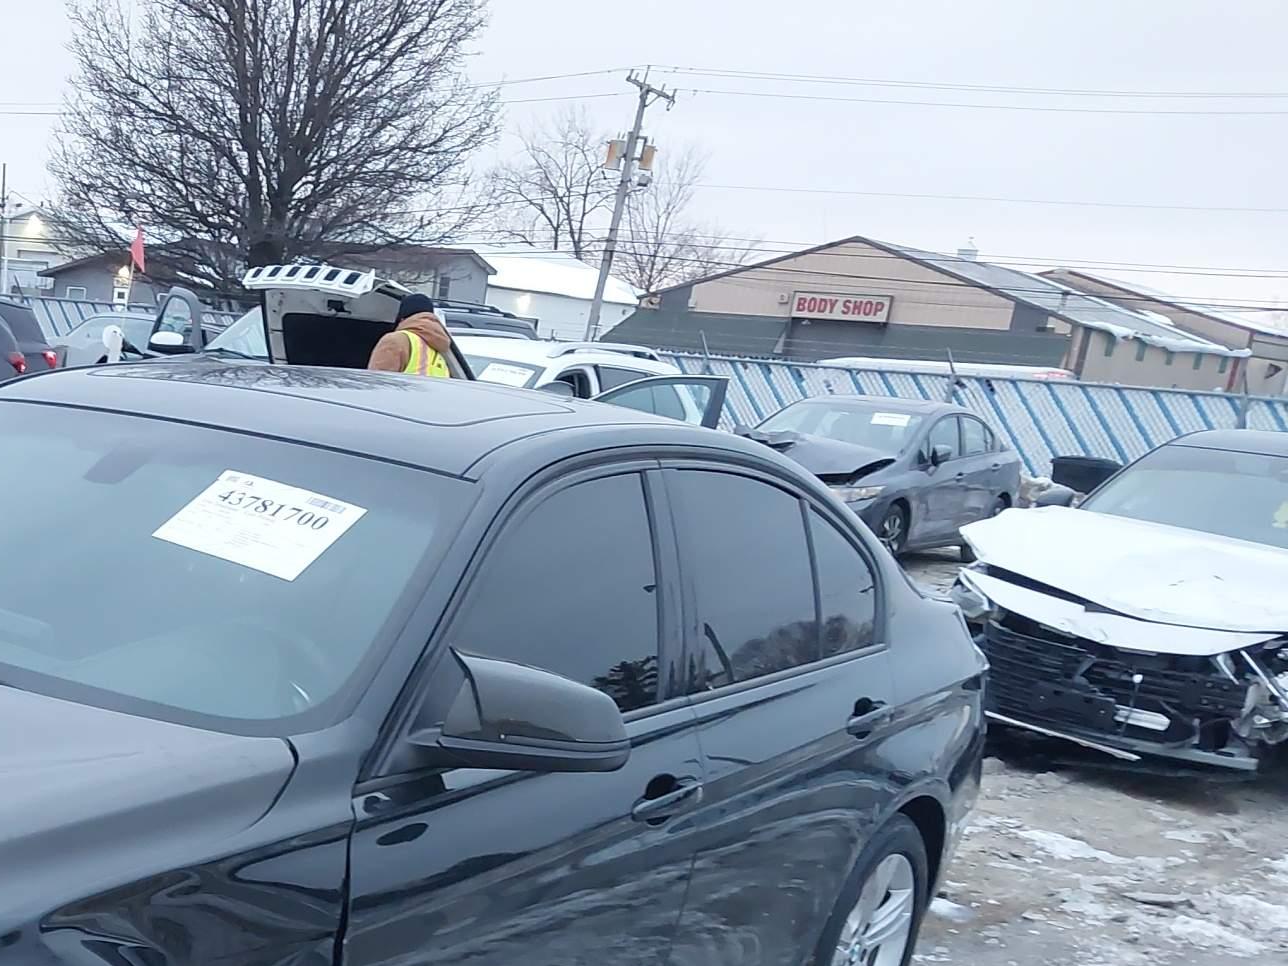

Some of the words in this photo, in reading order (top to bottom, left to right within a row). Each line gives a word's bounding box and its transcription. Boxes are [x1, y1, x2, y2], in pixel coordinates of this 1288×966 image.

[795, 297, 838, 314] BODY
[841, 299, 885, 317] SHOP
[217, 490, 330, 530] 43781700
